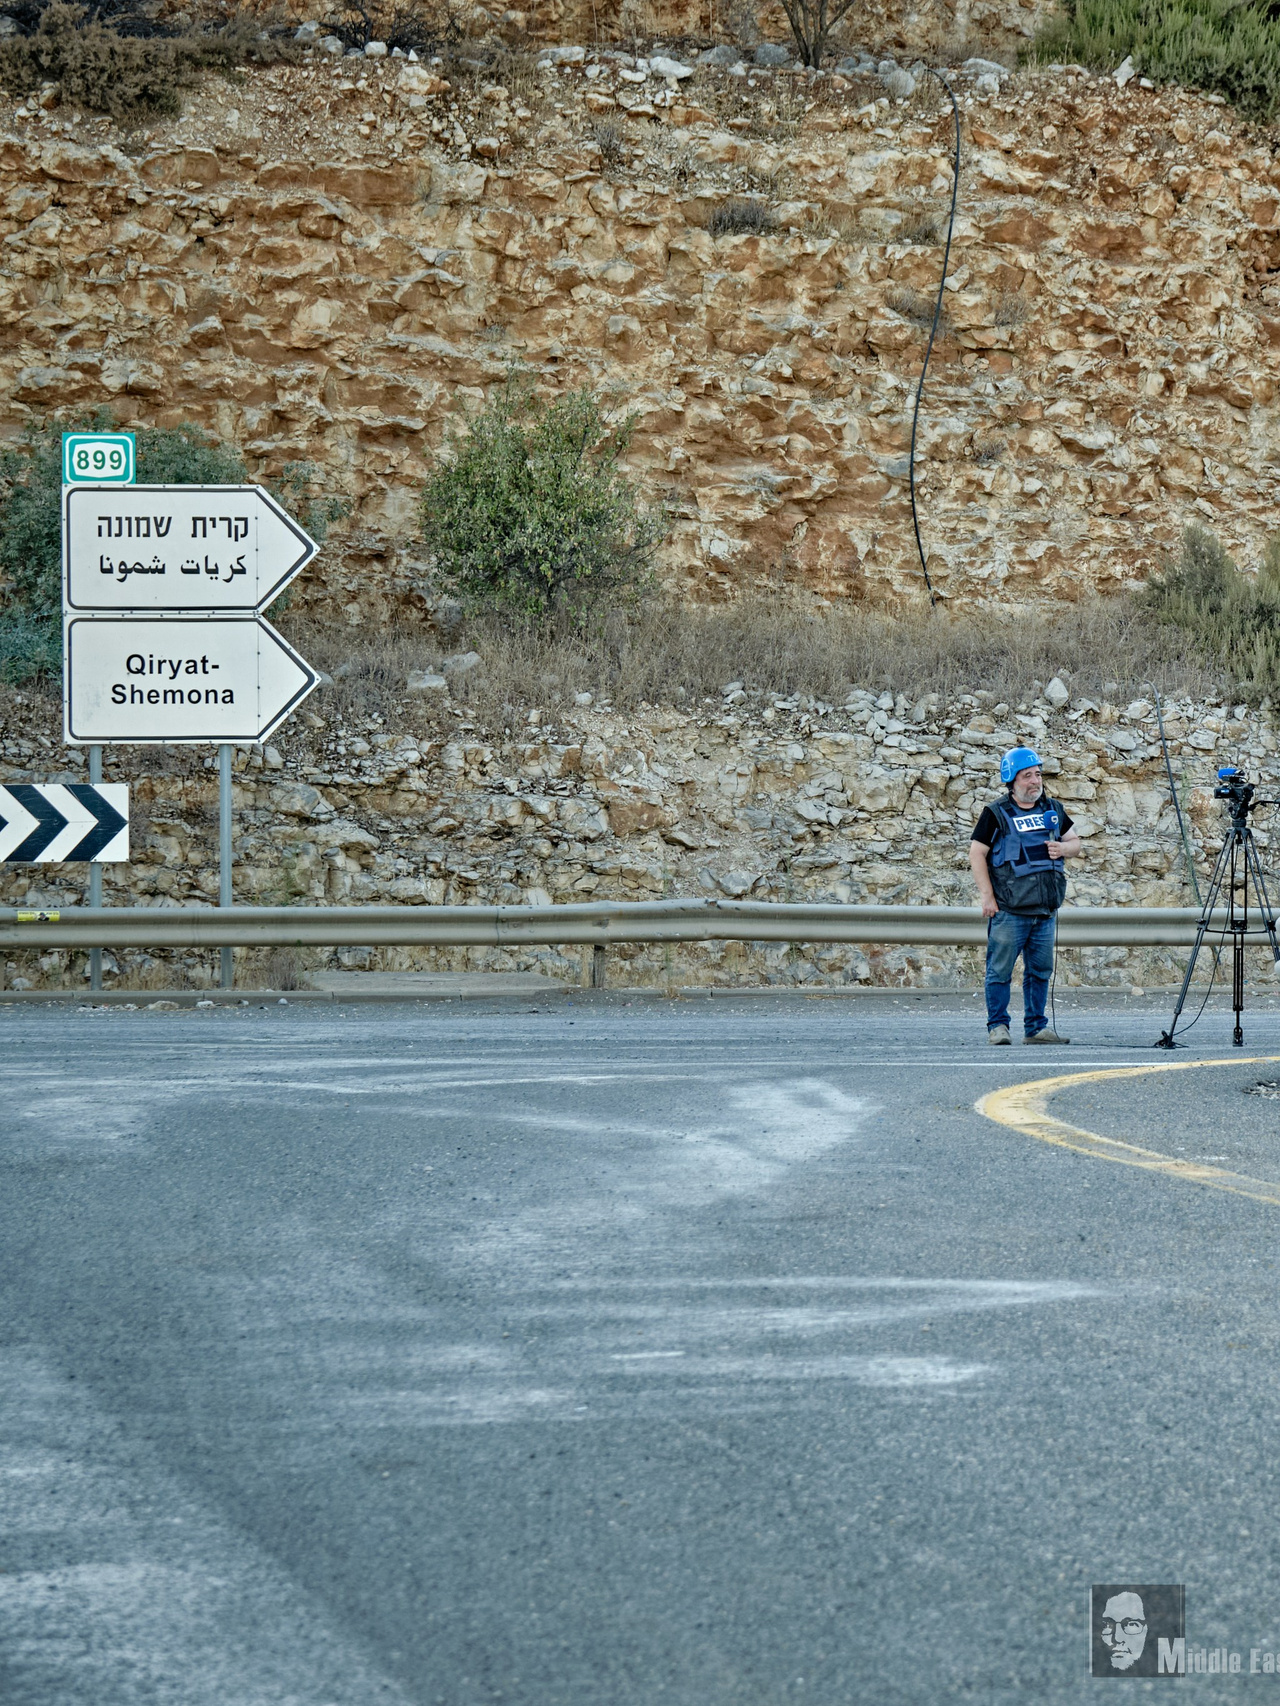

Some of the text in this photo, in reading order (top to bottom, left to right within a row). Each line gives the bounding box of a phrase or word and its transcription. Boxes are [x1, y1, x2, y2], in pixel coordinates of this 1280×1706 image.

[77, 450, 122, 470] 899
[98, 516, 249, 542] קרית שמונה
[99, 554, 247, 583] كريات شمونا
[126, 654, 220, 680] Qiryat-
[111, 684, 235, 704] Shemona
[1016, 816, 1045, 830] PRES
